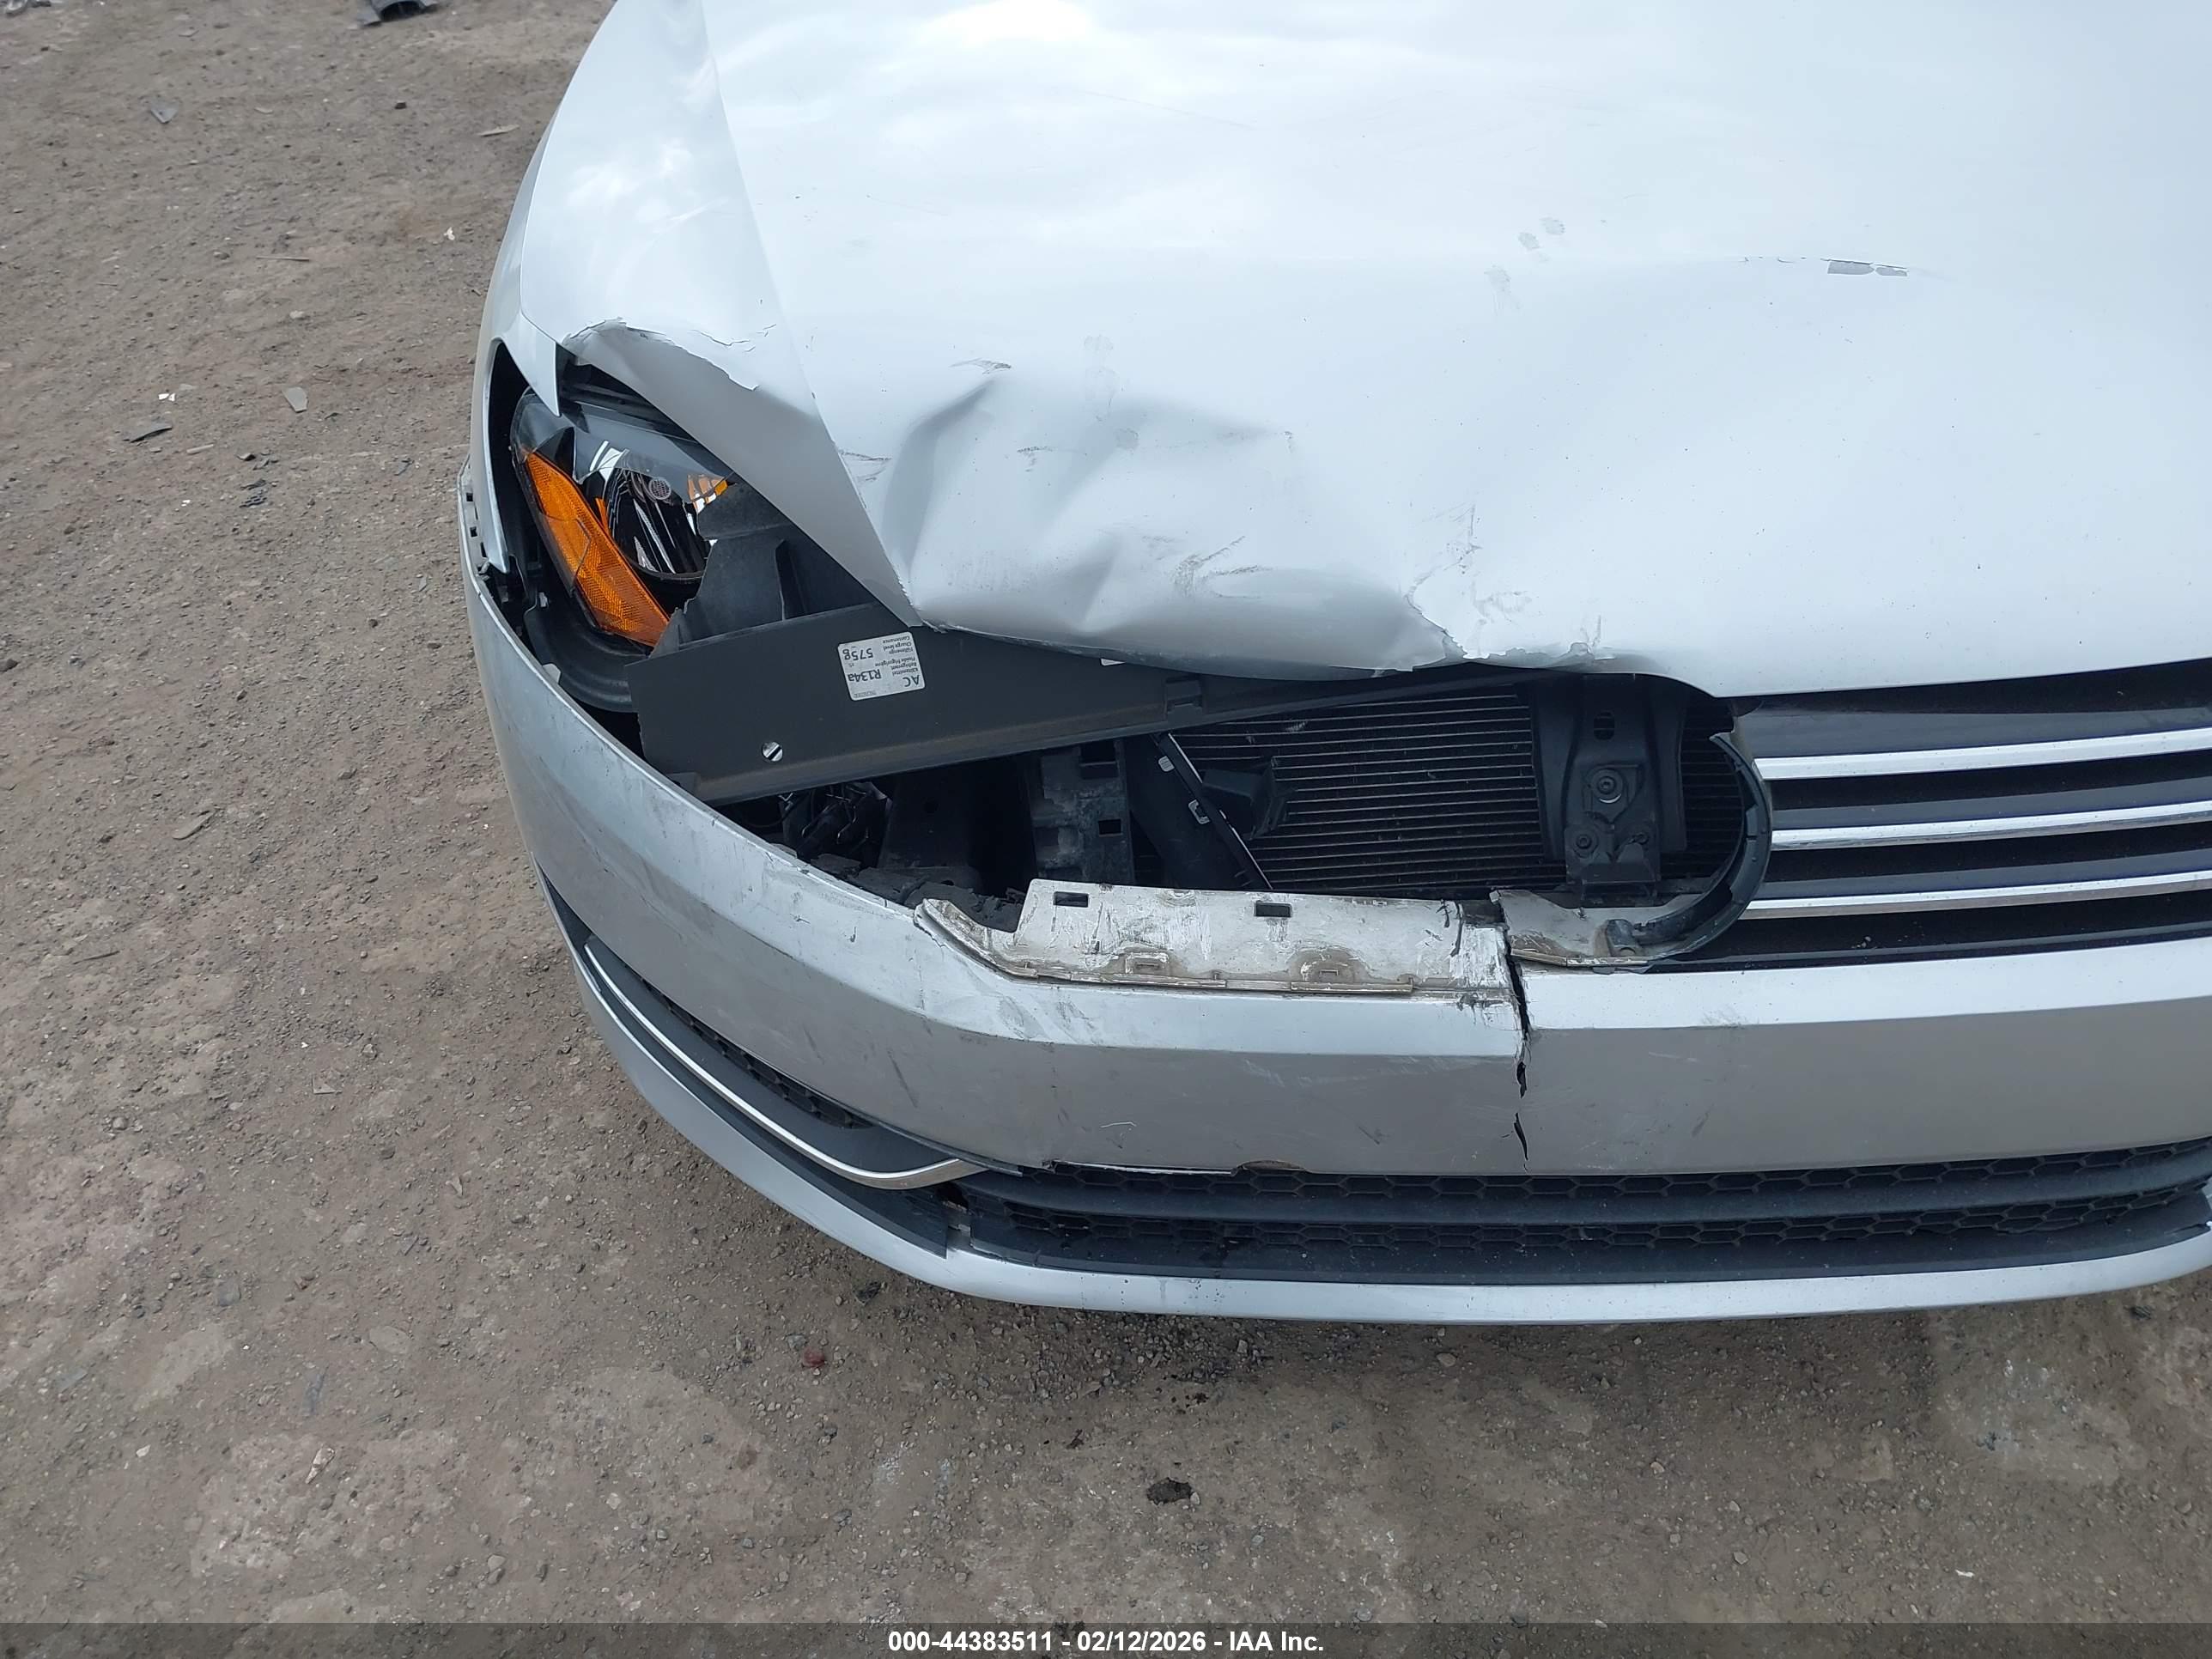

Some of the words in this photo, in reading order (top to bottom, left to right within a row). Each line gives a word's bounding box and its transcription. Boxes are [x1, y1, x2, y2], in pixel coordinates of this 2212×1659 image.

[842, 648, 873, 660] 575g
[848, 669, 881, 682] R134a
[902, 675, 921, 687] AC
